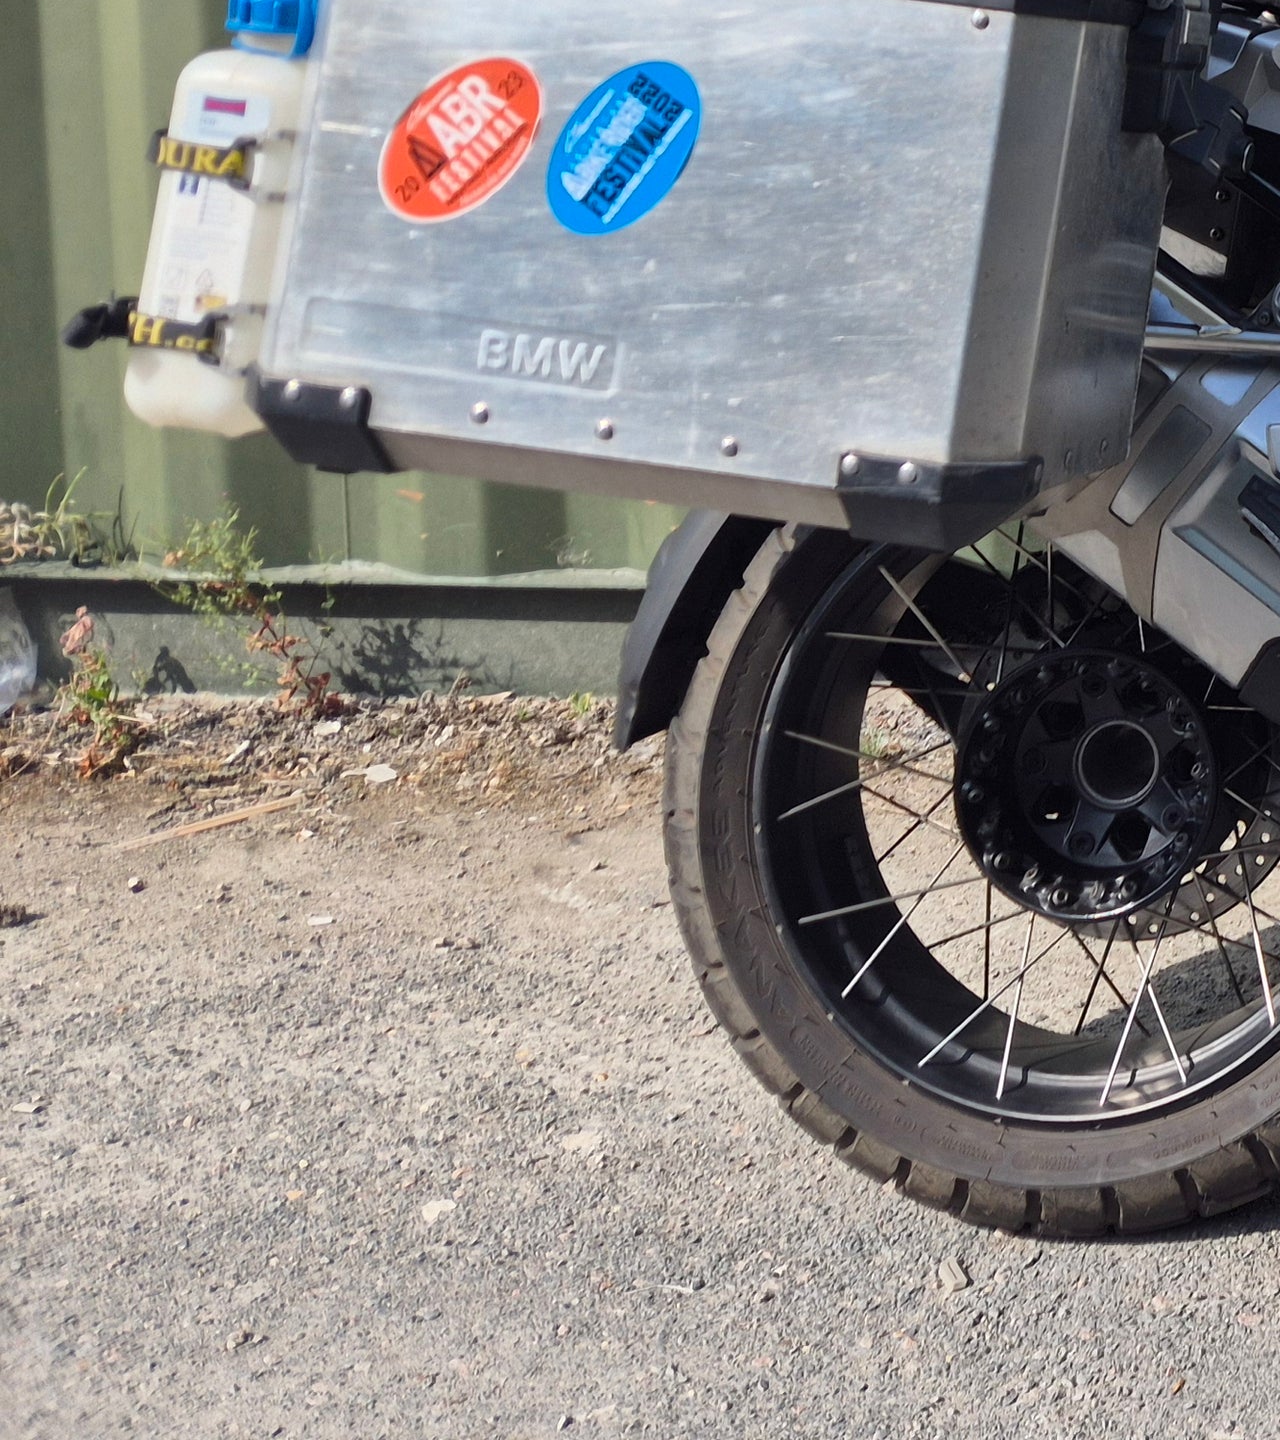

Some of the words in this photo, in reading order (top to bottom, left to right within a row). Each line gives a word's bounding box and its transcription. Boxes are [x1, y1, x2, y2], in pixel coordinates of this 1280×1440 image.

[424, 73, 508, 162] ABR
[627, 71, 684, 124] 2022
[477, 329, 607, 383] BMW
